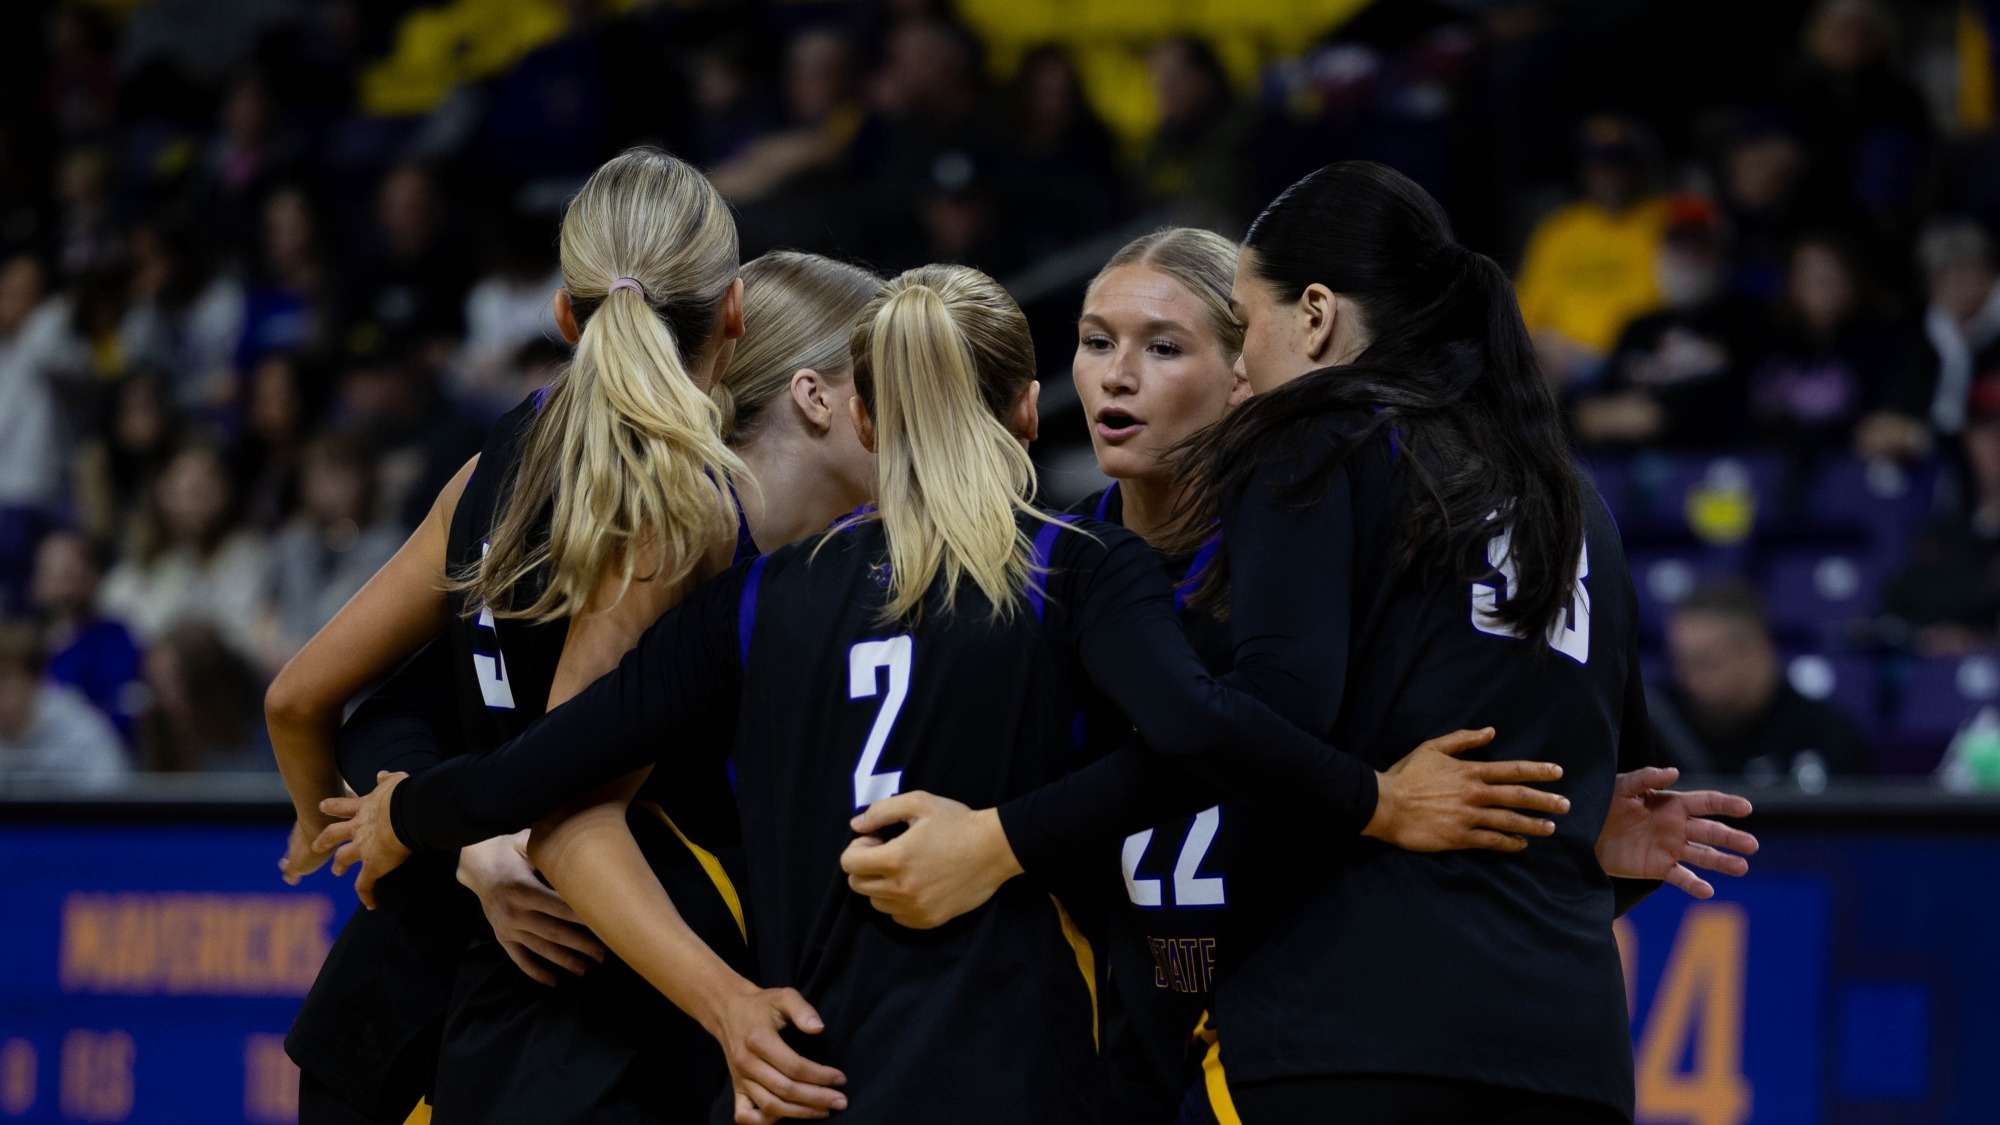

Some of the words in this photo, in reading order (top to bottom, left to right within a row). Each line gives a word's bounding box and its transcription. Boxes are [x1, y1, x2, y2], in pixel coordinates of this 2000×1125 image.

[849, 633, 913, 809] 2
[1121, 804, 1226, 906] 22
[1613, 903, 1753, 1122] 4
